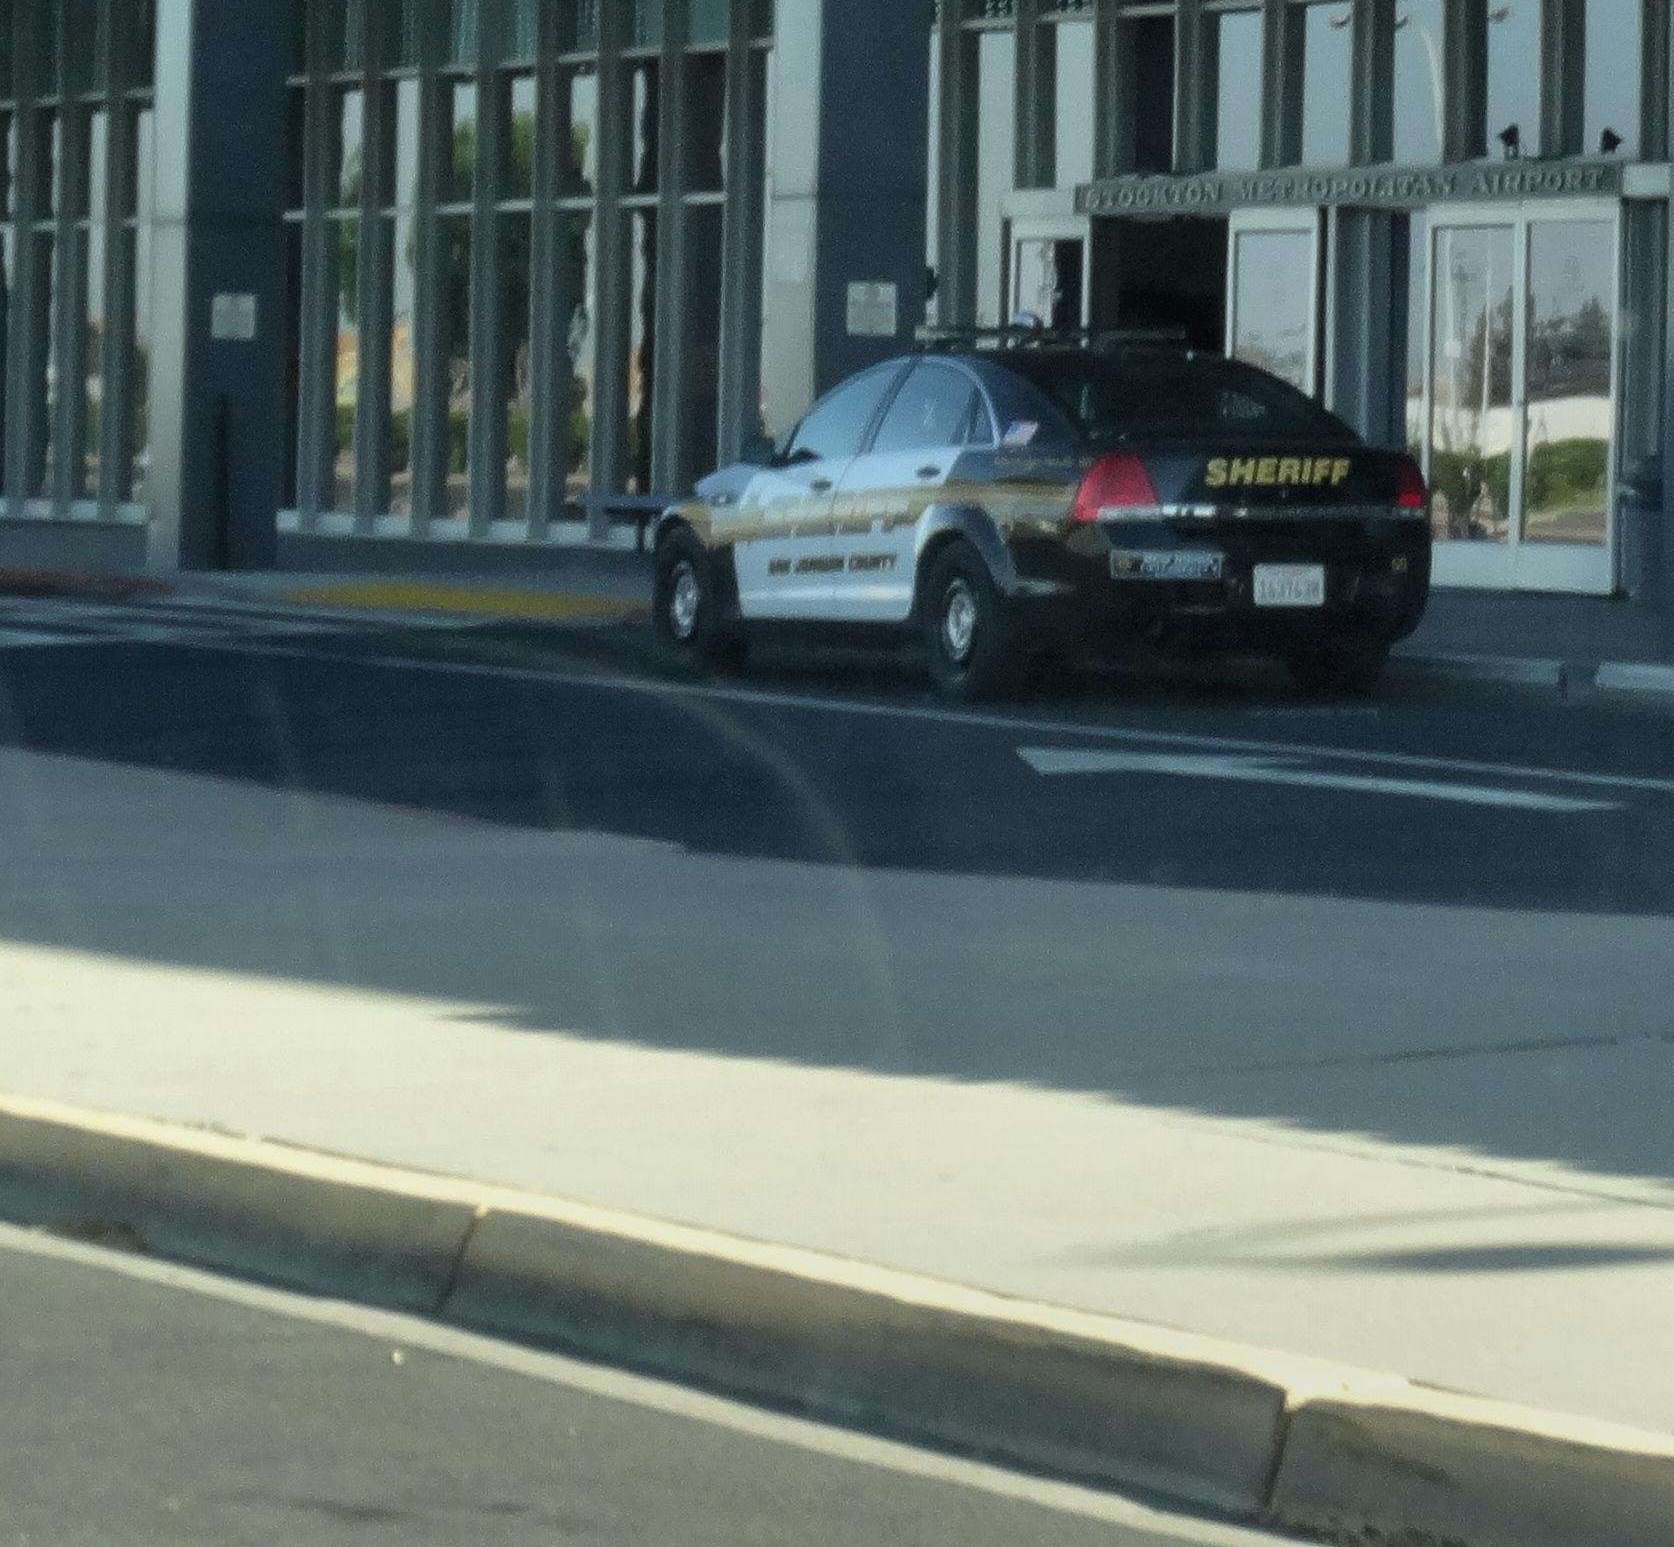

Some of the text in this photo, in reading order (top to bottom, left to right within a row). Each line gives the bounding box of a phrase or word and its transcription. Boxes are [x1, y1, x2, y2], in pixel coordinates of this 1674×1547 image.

[1086, 167, 1604, 208] STOCKTON METROPOLITAN AIRPORT
[1205, 456, 1351, 487] SHERIFF
[849, 553, 898, 571] COUNTY
